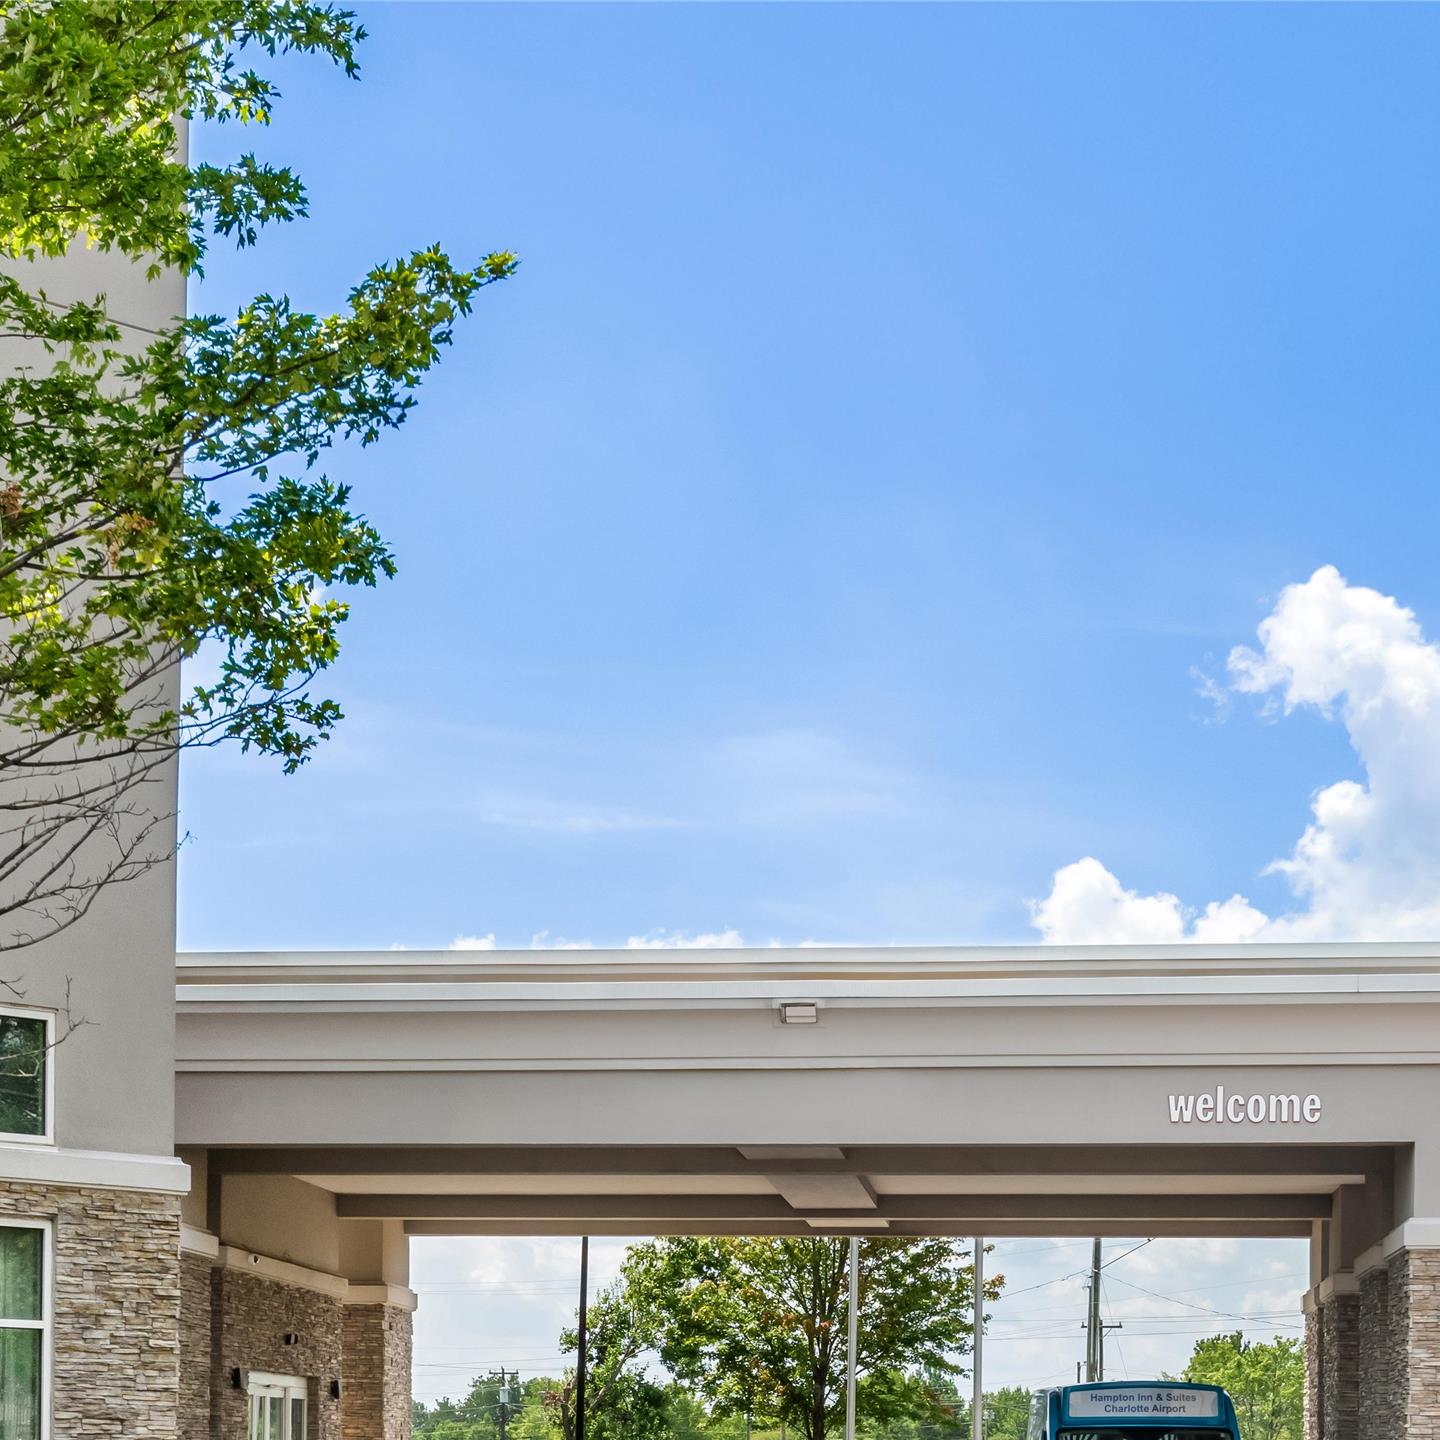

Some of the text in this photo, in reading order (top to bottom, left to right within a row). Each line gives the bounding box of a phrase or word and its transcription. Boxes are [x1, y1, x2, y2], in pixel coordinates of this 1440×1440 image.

[1168, 1085, 1322, 1123] welcome
[1090, 1393, 1197, 1403] Hampton Inn & Suites
[1104, 1404, 1186, 1414] Charlotte Airport
